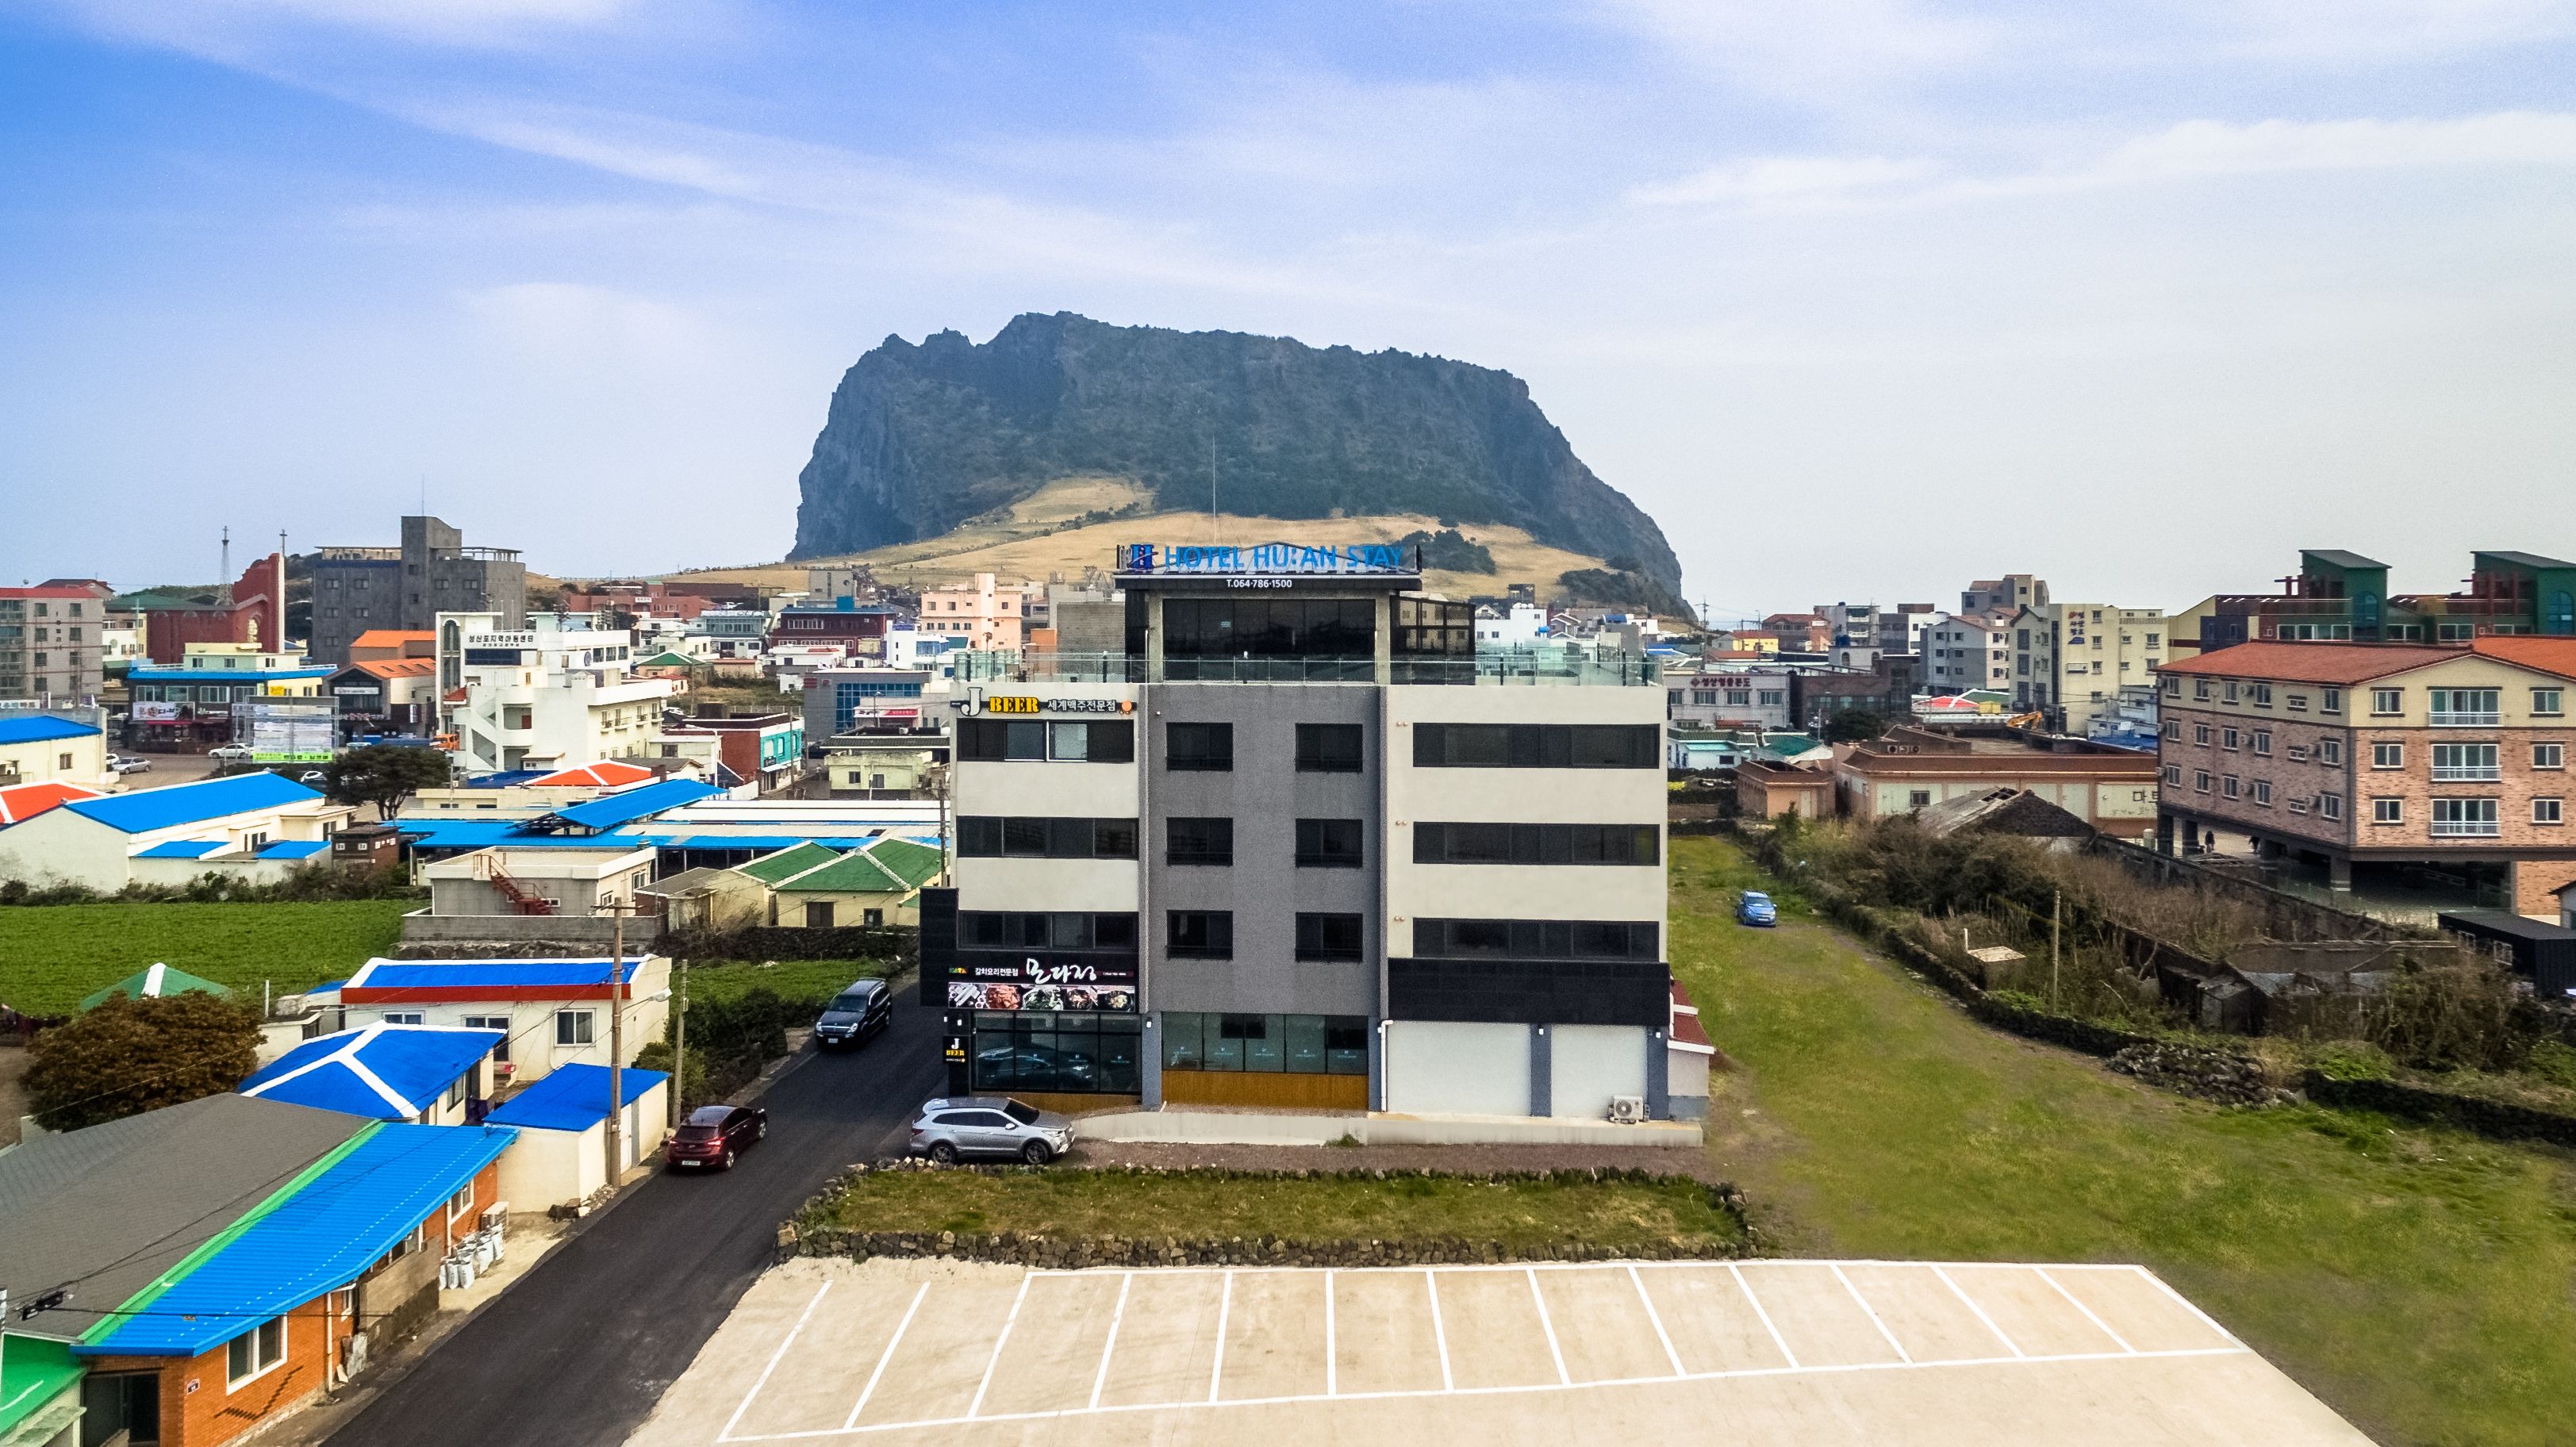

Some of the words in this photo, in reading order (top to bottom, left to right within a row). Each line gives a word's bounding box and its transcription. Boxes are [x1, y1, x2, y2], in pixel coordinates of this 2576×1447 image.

[1165, 546, 1245, 569] HOTEL
[1253, 545, 1337, 569] HU:AN
[1346, 546, 1403, 569] STAY
[961, 687, 983, 716] J
[989, 697, 1041, 713] BEER
[1047, 700, 1116, 712] 세계맥주전문점
[950, 1038, 960, 1050] J
